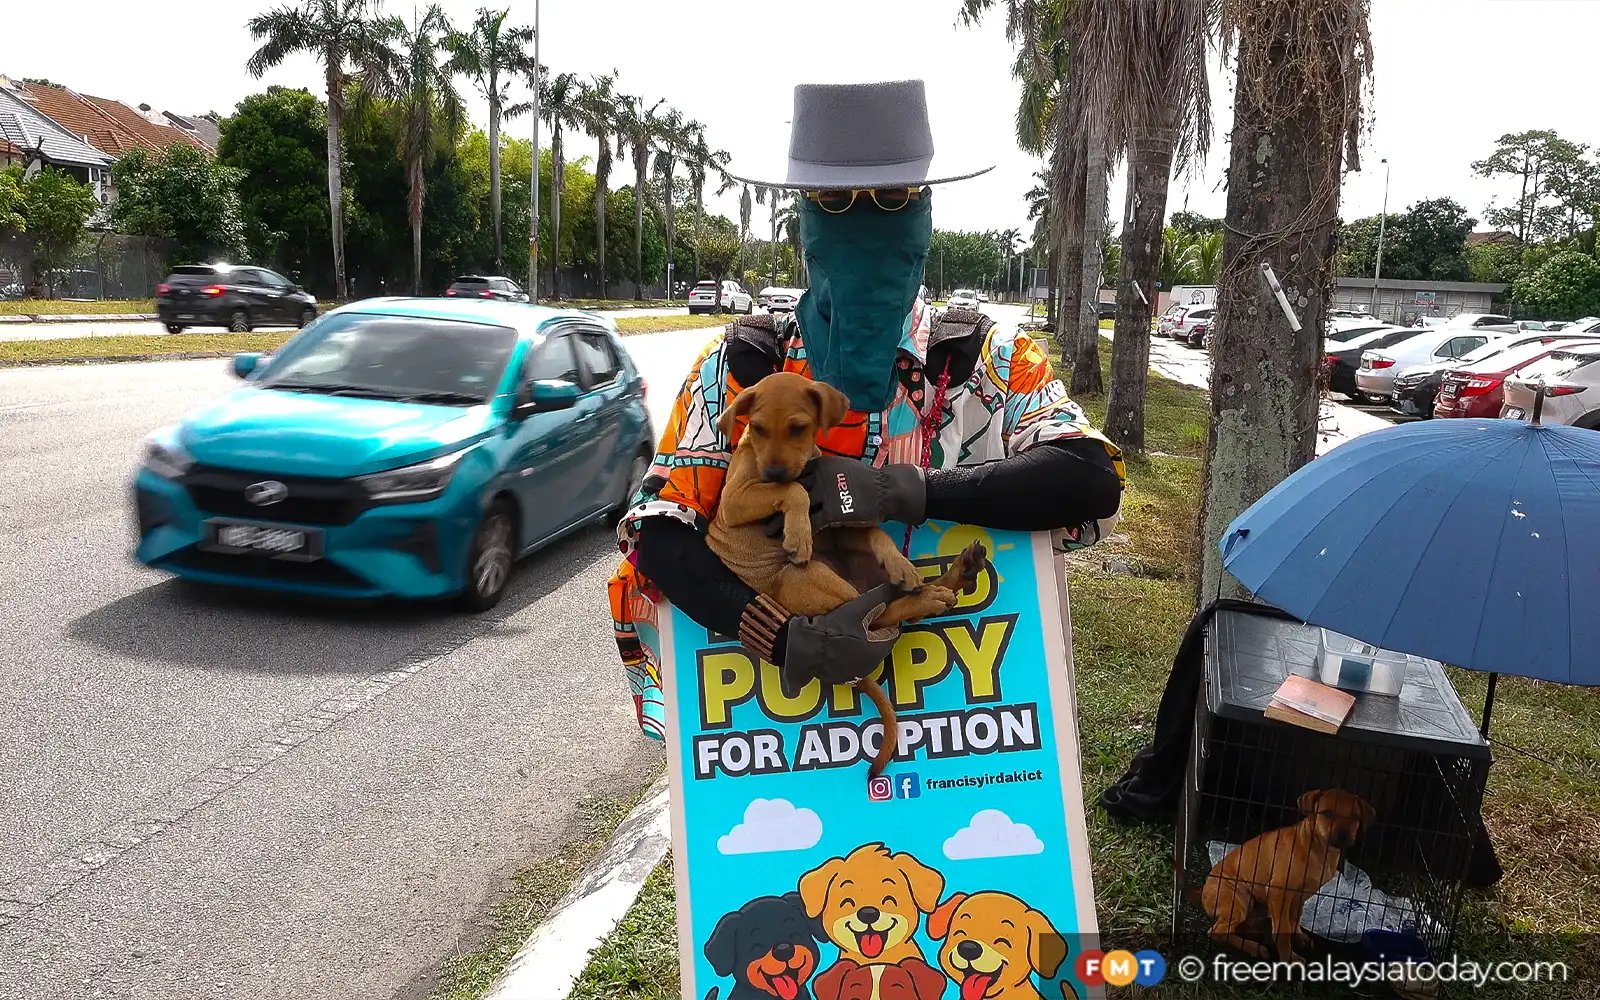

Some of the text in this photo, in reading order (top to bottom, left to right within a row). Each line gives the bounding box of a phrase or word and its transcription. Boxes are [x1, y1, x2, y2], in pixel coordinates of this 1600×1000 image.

[697, 707, 1037, 776] FOR ADOPTION
[925, 769, 1043, 790] francisyirdakict
